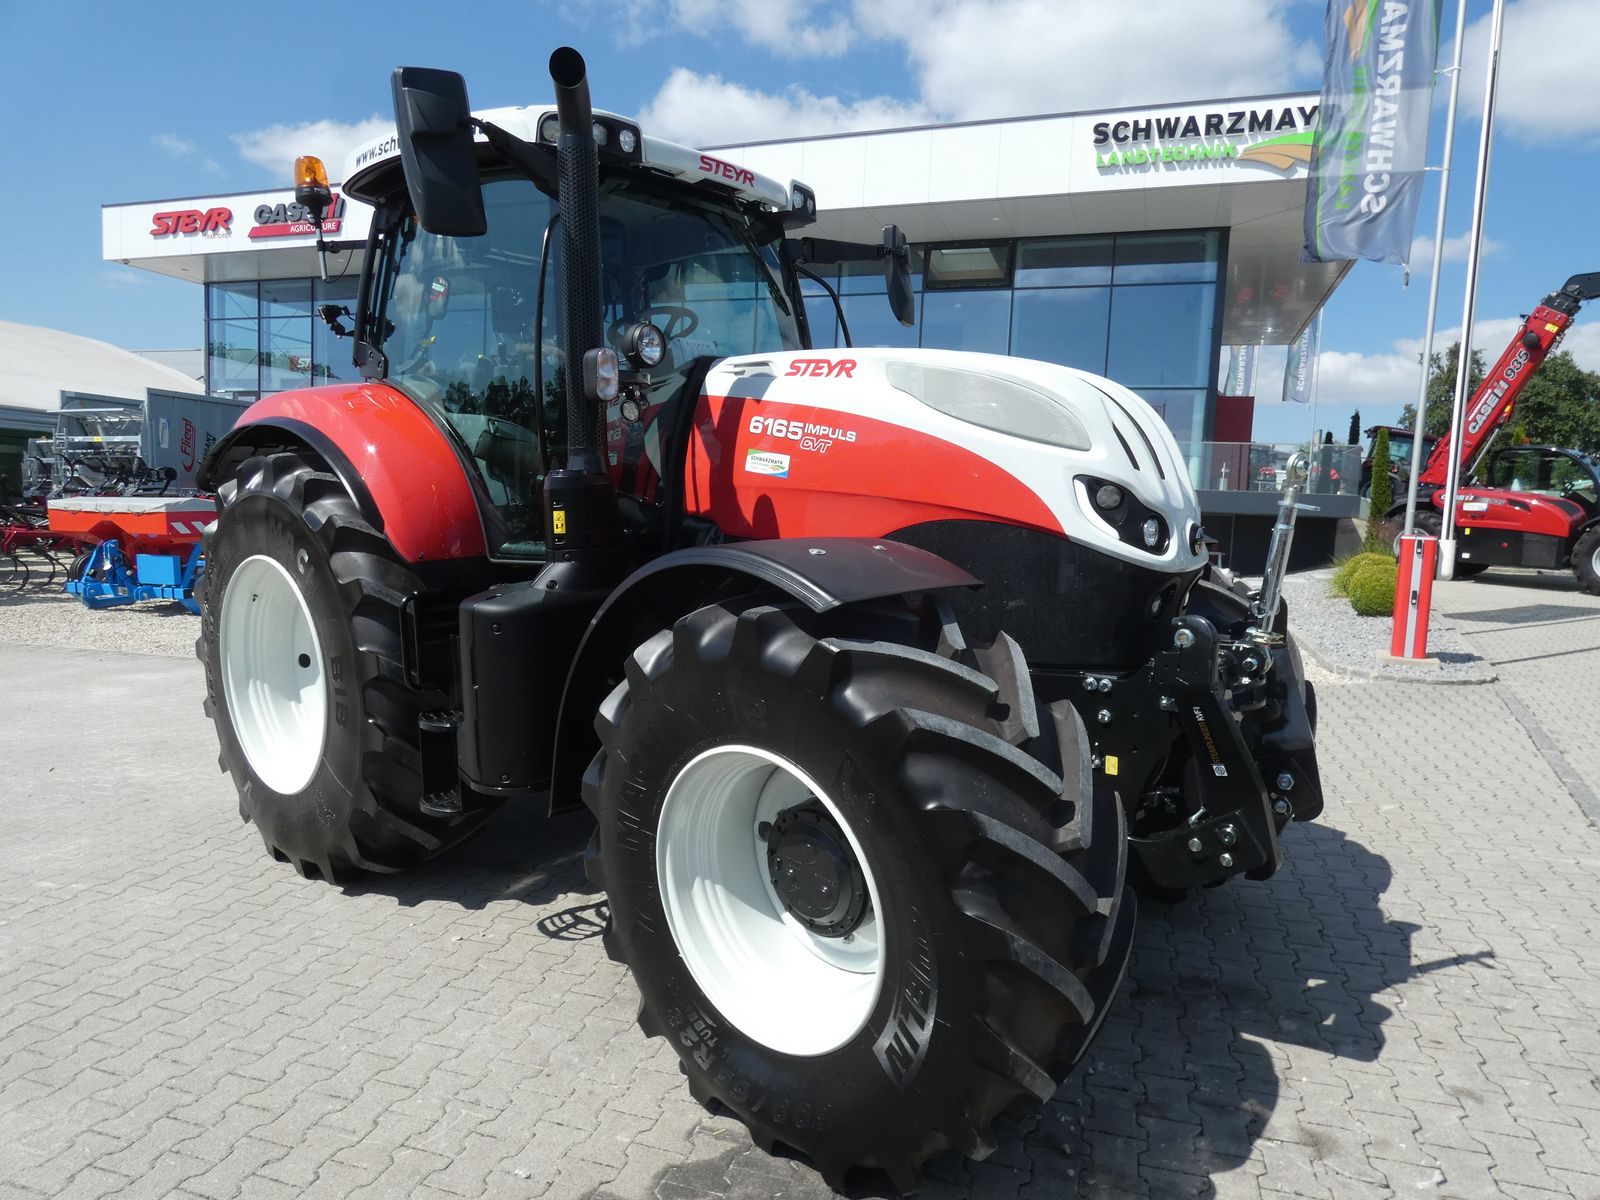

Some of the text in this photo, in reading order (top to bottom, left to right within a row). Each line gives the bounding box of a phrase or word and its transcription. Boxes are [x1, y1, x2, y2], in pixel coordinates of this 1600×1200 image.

[1096, 143, 1237, 168] LANDTECHNIK
[699, 154, 755, 188] STEYR
[150, 207, 232, 236] STEYR
[290, 223, 336, 233] AGRICUURE
[784, 358, 857, 378] STEYR
[1504, 349, 1530, 381] 935
[749, 416, 857, 442] 6165 IMPULS
[800, 436, 832, 453] CVT
